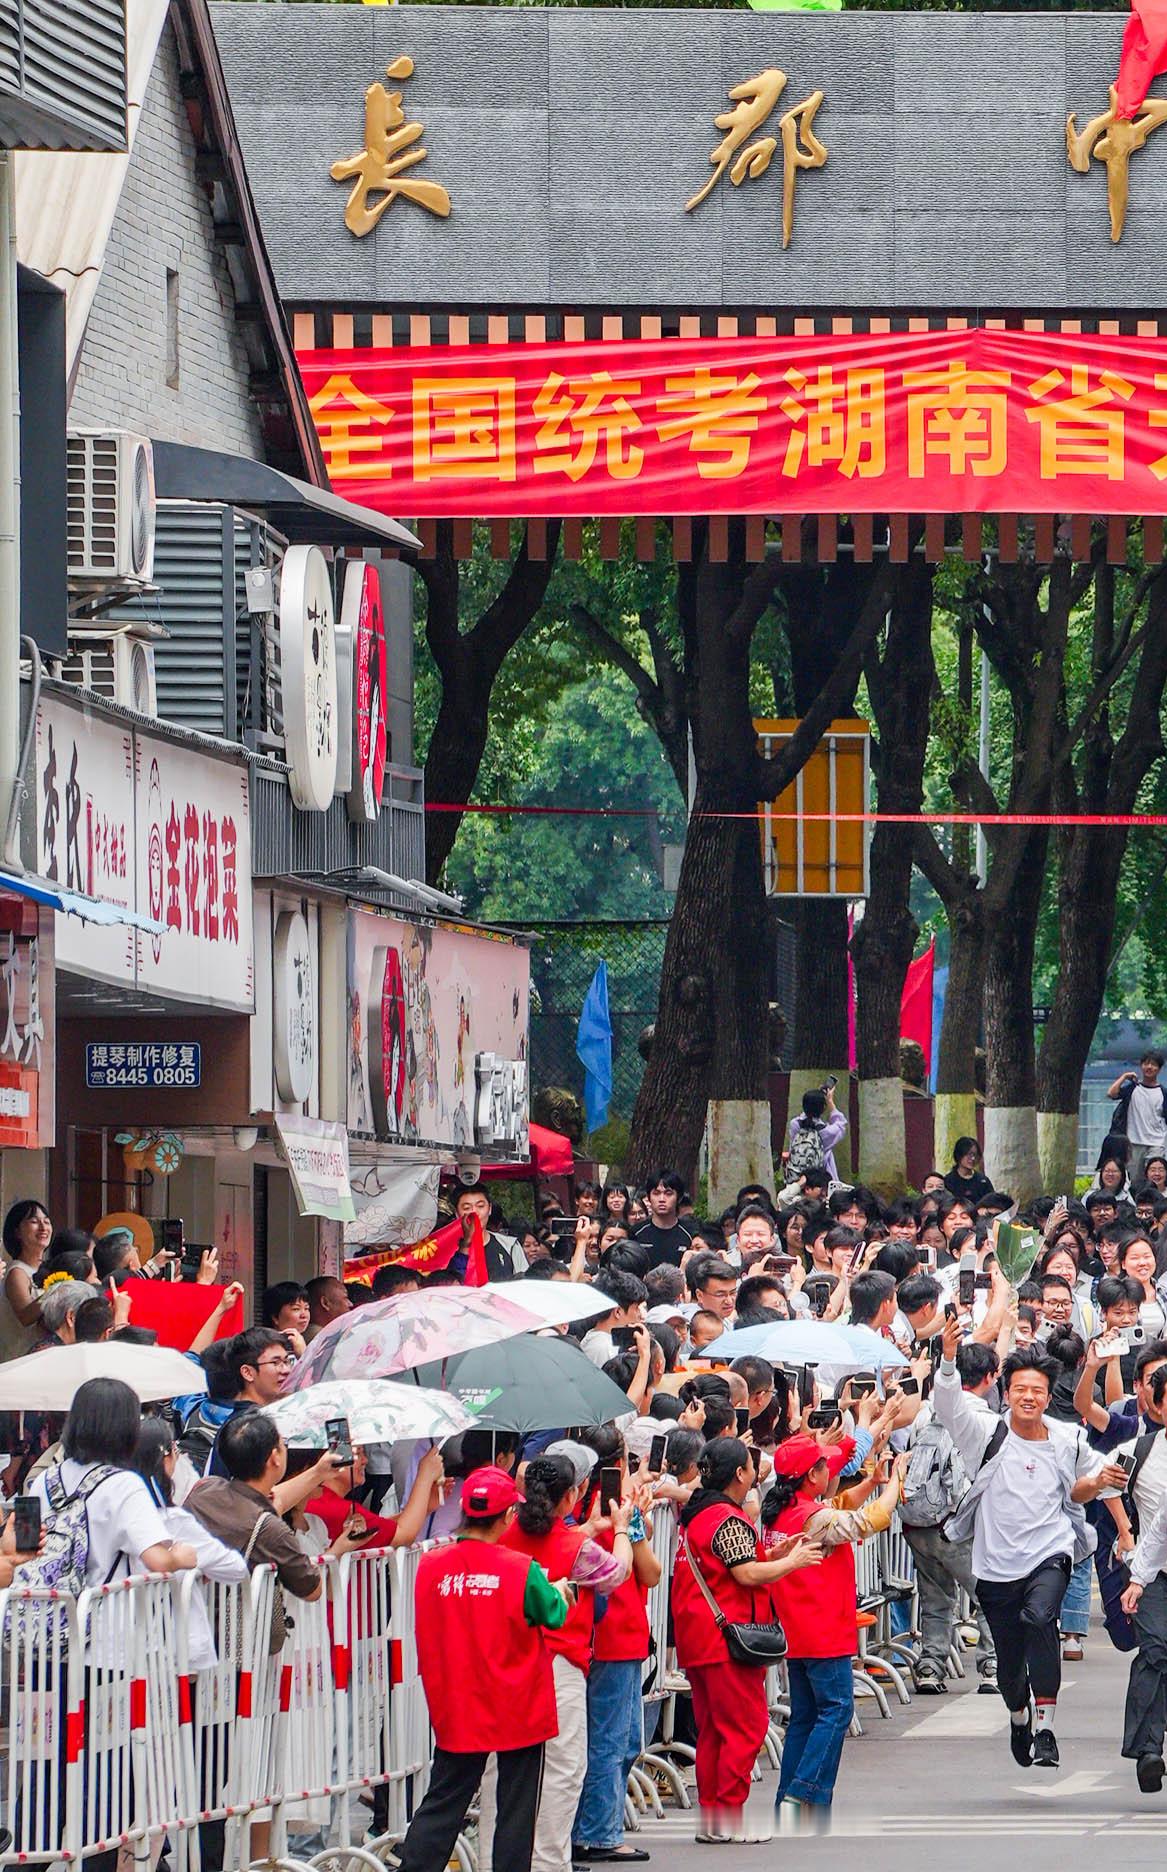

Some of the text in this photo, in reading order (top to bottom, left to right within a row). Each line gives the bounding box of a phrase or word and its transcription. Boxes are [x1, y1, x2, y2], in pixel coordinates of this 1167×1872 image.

[165, 799, 239, 946] 金花泡菜
[91, 1046, 196, 1067] 提琴制作修复
[106, 1069, 196, 1085] 8445 0805
